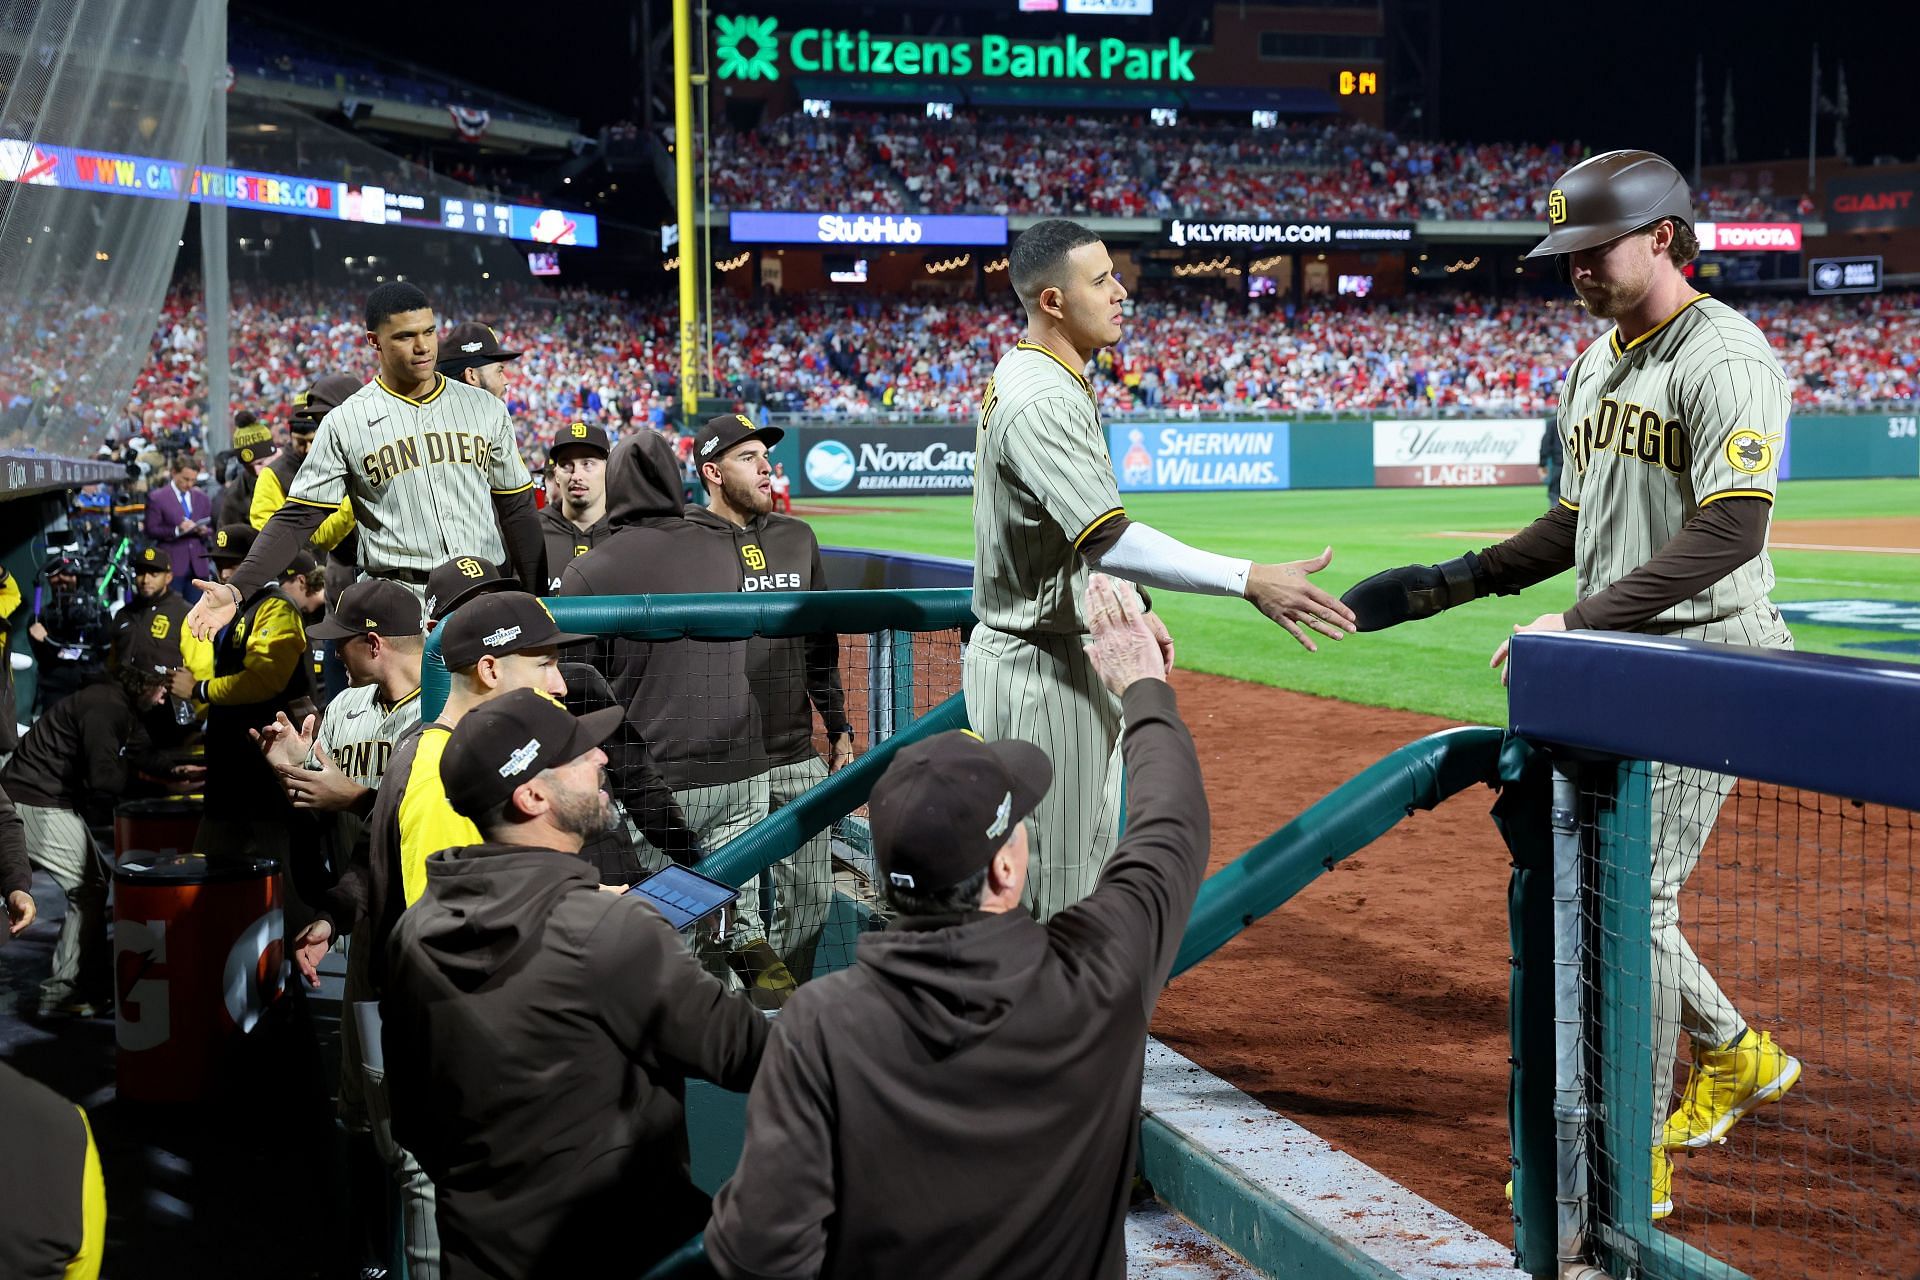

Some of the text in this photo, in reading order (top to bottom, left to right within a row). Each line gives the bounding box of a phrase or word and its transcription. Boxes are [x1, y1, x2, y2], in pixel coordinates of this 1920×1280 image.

[790, 28, 1195, 81] Citizens Bank Park
[1549, 189, 1567, 225] SD
[1834, 191, 1913, 213] GIANT
[818, 214, 921, 243] StubHub
[1187, 224, 1331, 243] KLYRRUM.COM
[1717, 228, 1796, 246] TOYOTA
[571, 422, 587, 439] SD
[1888, 417, 1917, 438] 374
[1158, 428, 1274, 457] SHERWIN
[1397, 424, 1524, 462] Yuengling
[363, 436, 421, 488] SAN
[1423, 465, 1497, 486] LAGER
[217, 531, 228, 548] SD
[457, 557, 484, 578] SD
[742, 544, 766, 570] SD
[742, 573, 801, 593] DRES
[151, 614, 171, 640] SD
[484, 628, 520, 645] POSTSEASON
